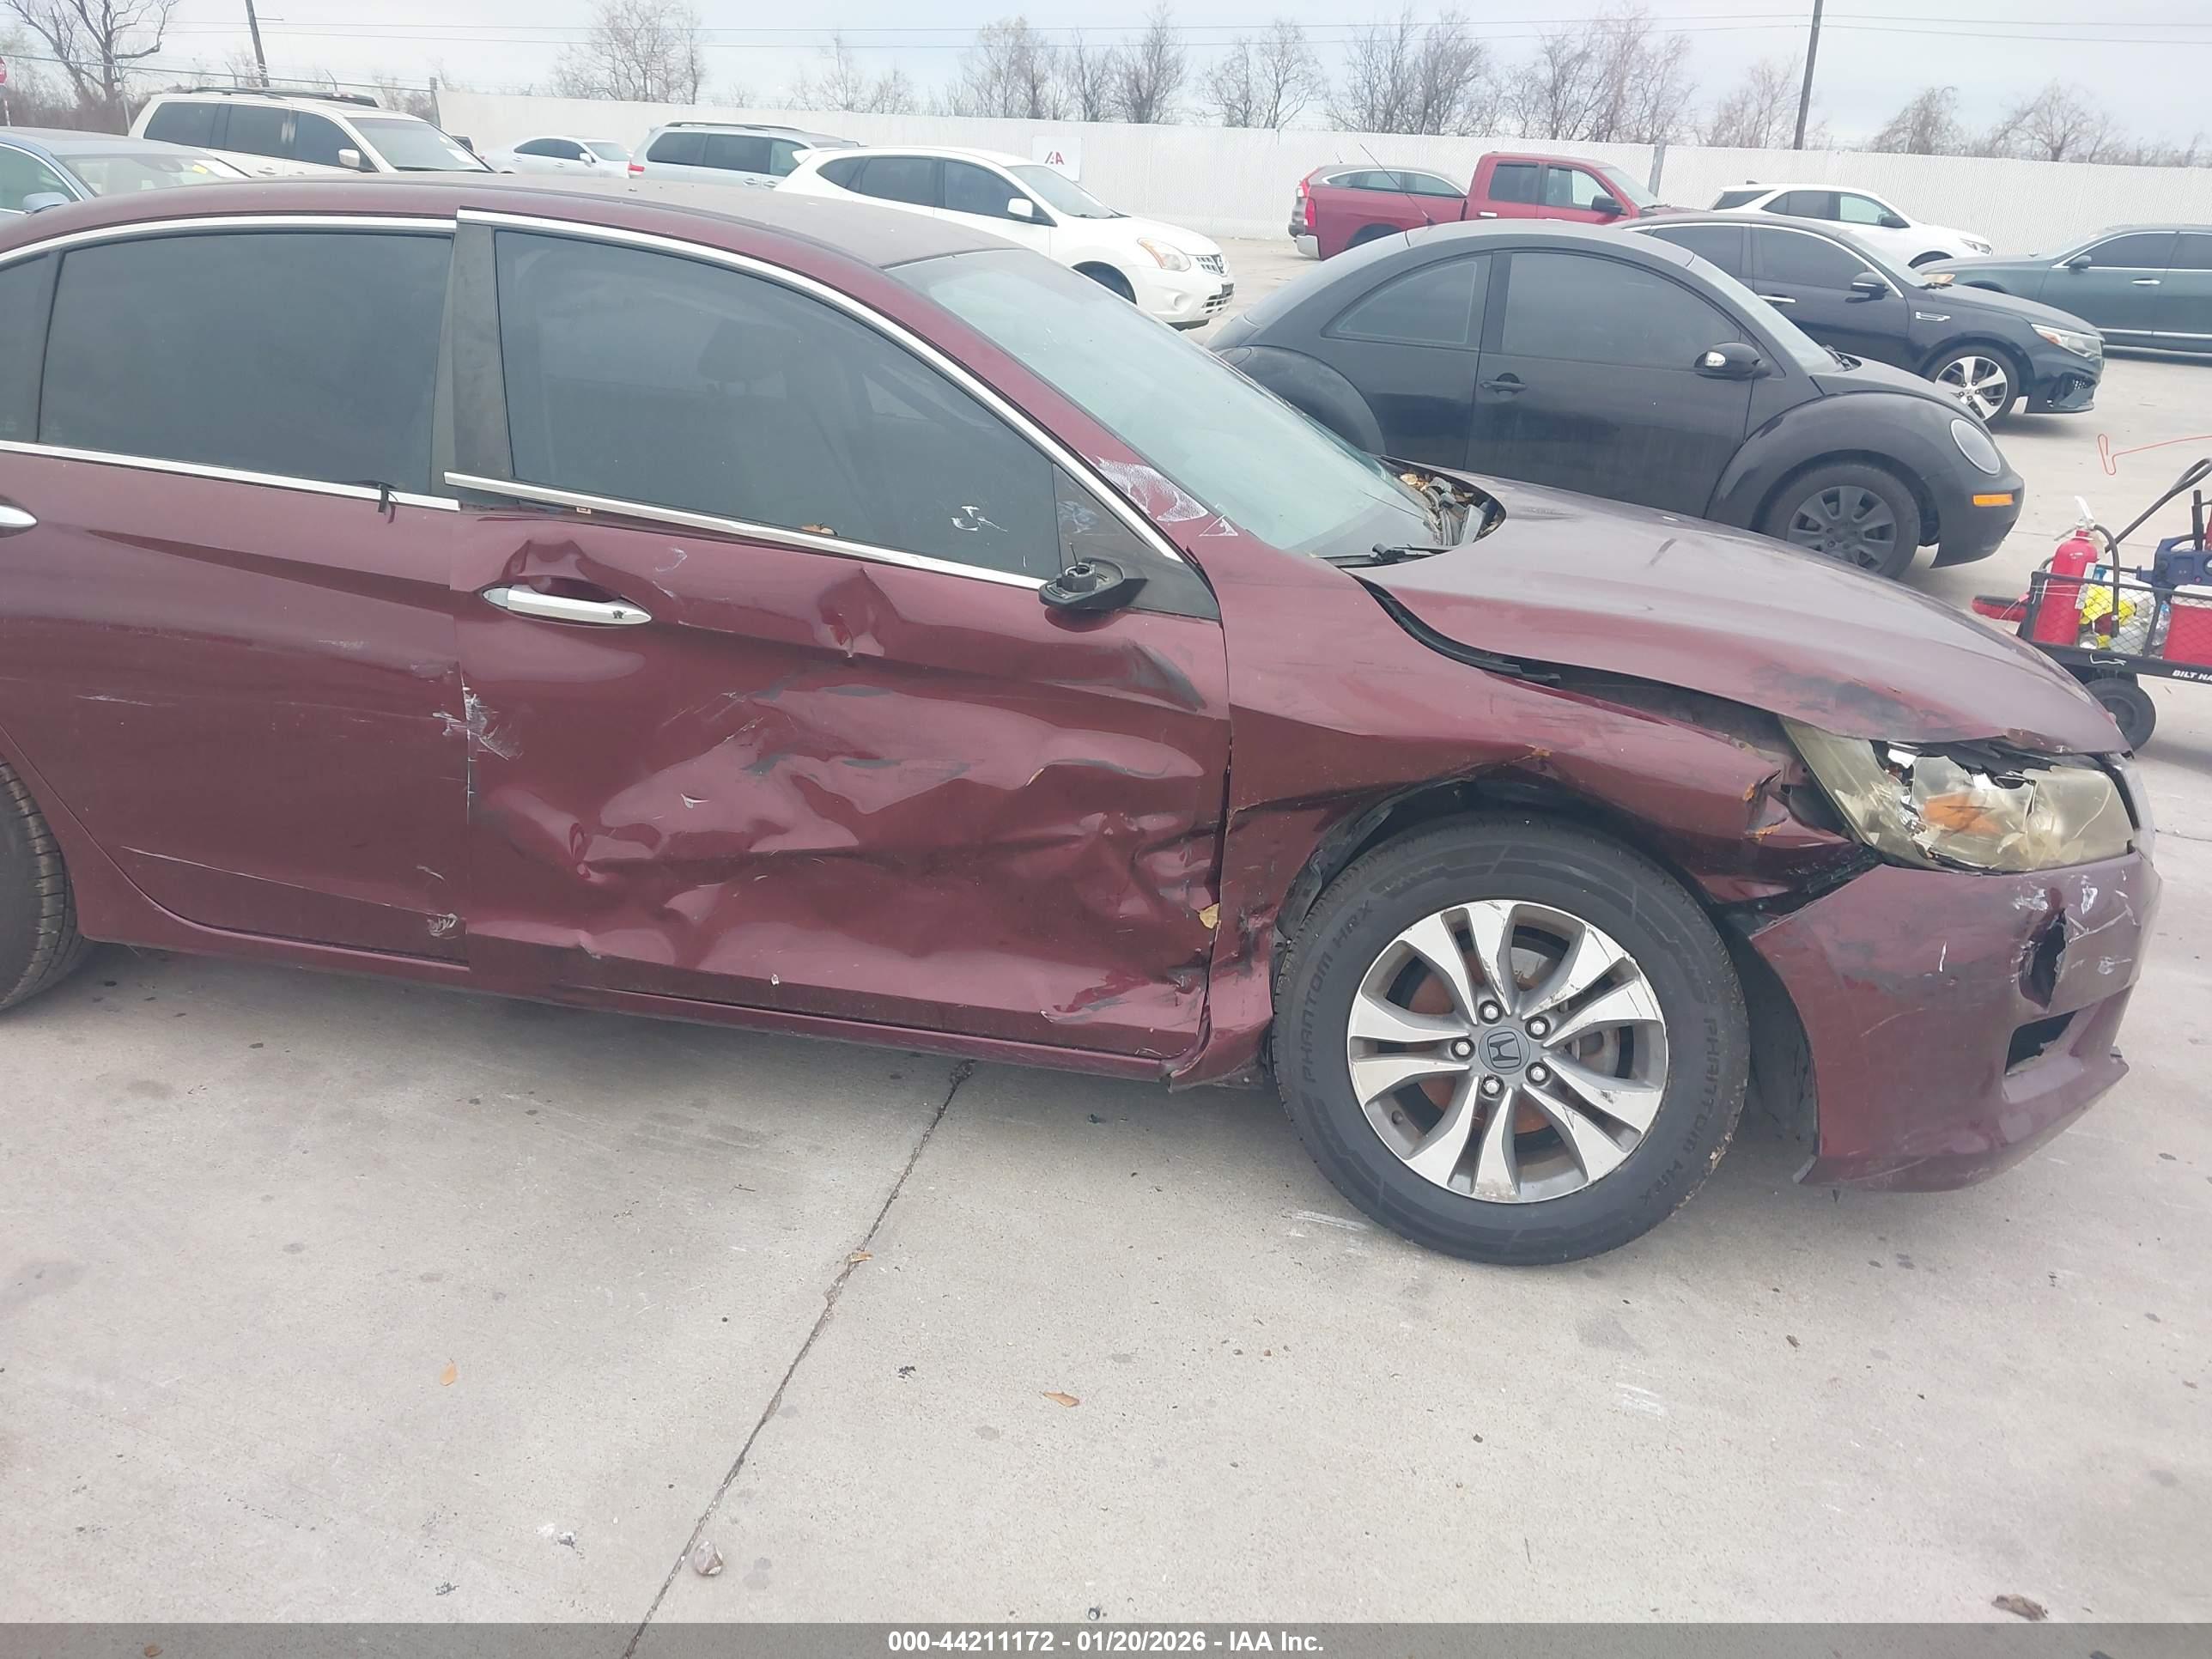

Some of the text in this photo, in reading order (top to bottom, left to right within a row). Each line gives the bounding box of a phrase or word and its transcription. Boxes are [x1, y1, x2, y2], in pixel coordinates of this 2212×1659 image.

[2172, 670, 2197, 678] BILT
[1300, 951, 1334, 1084] PHANTOM
[1683, 1018, 1720, 1154] PHANTOM
